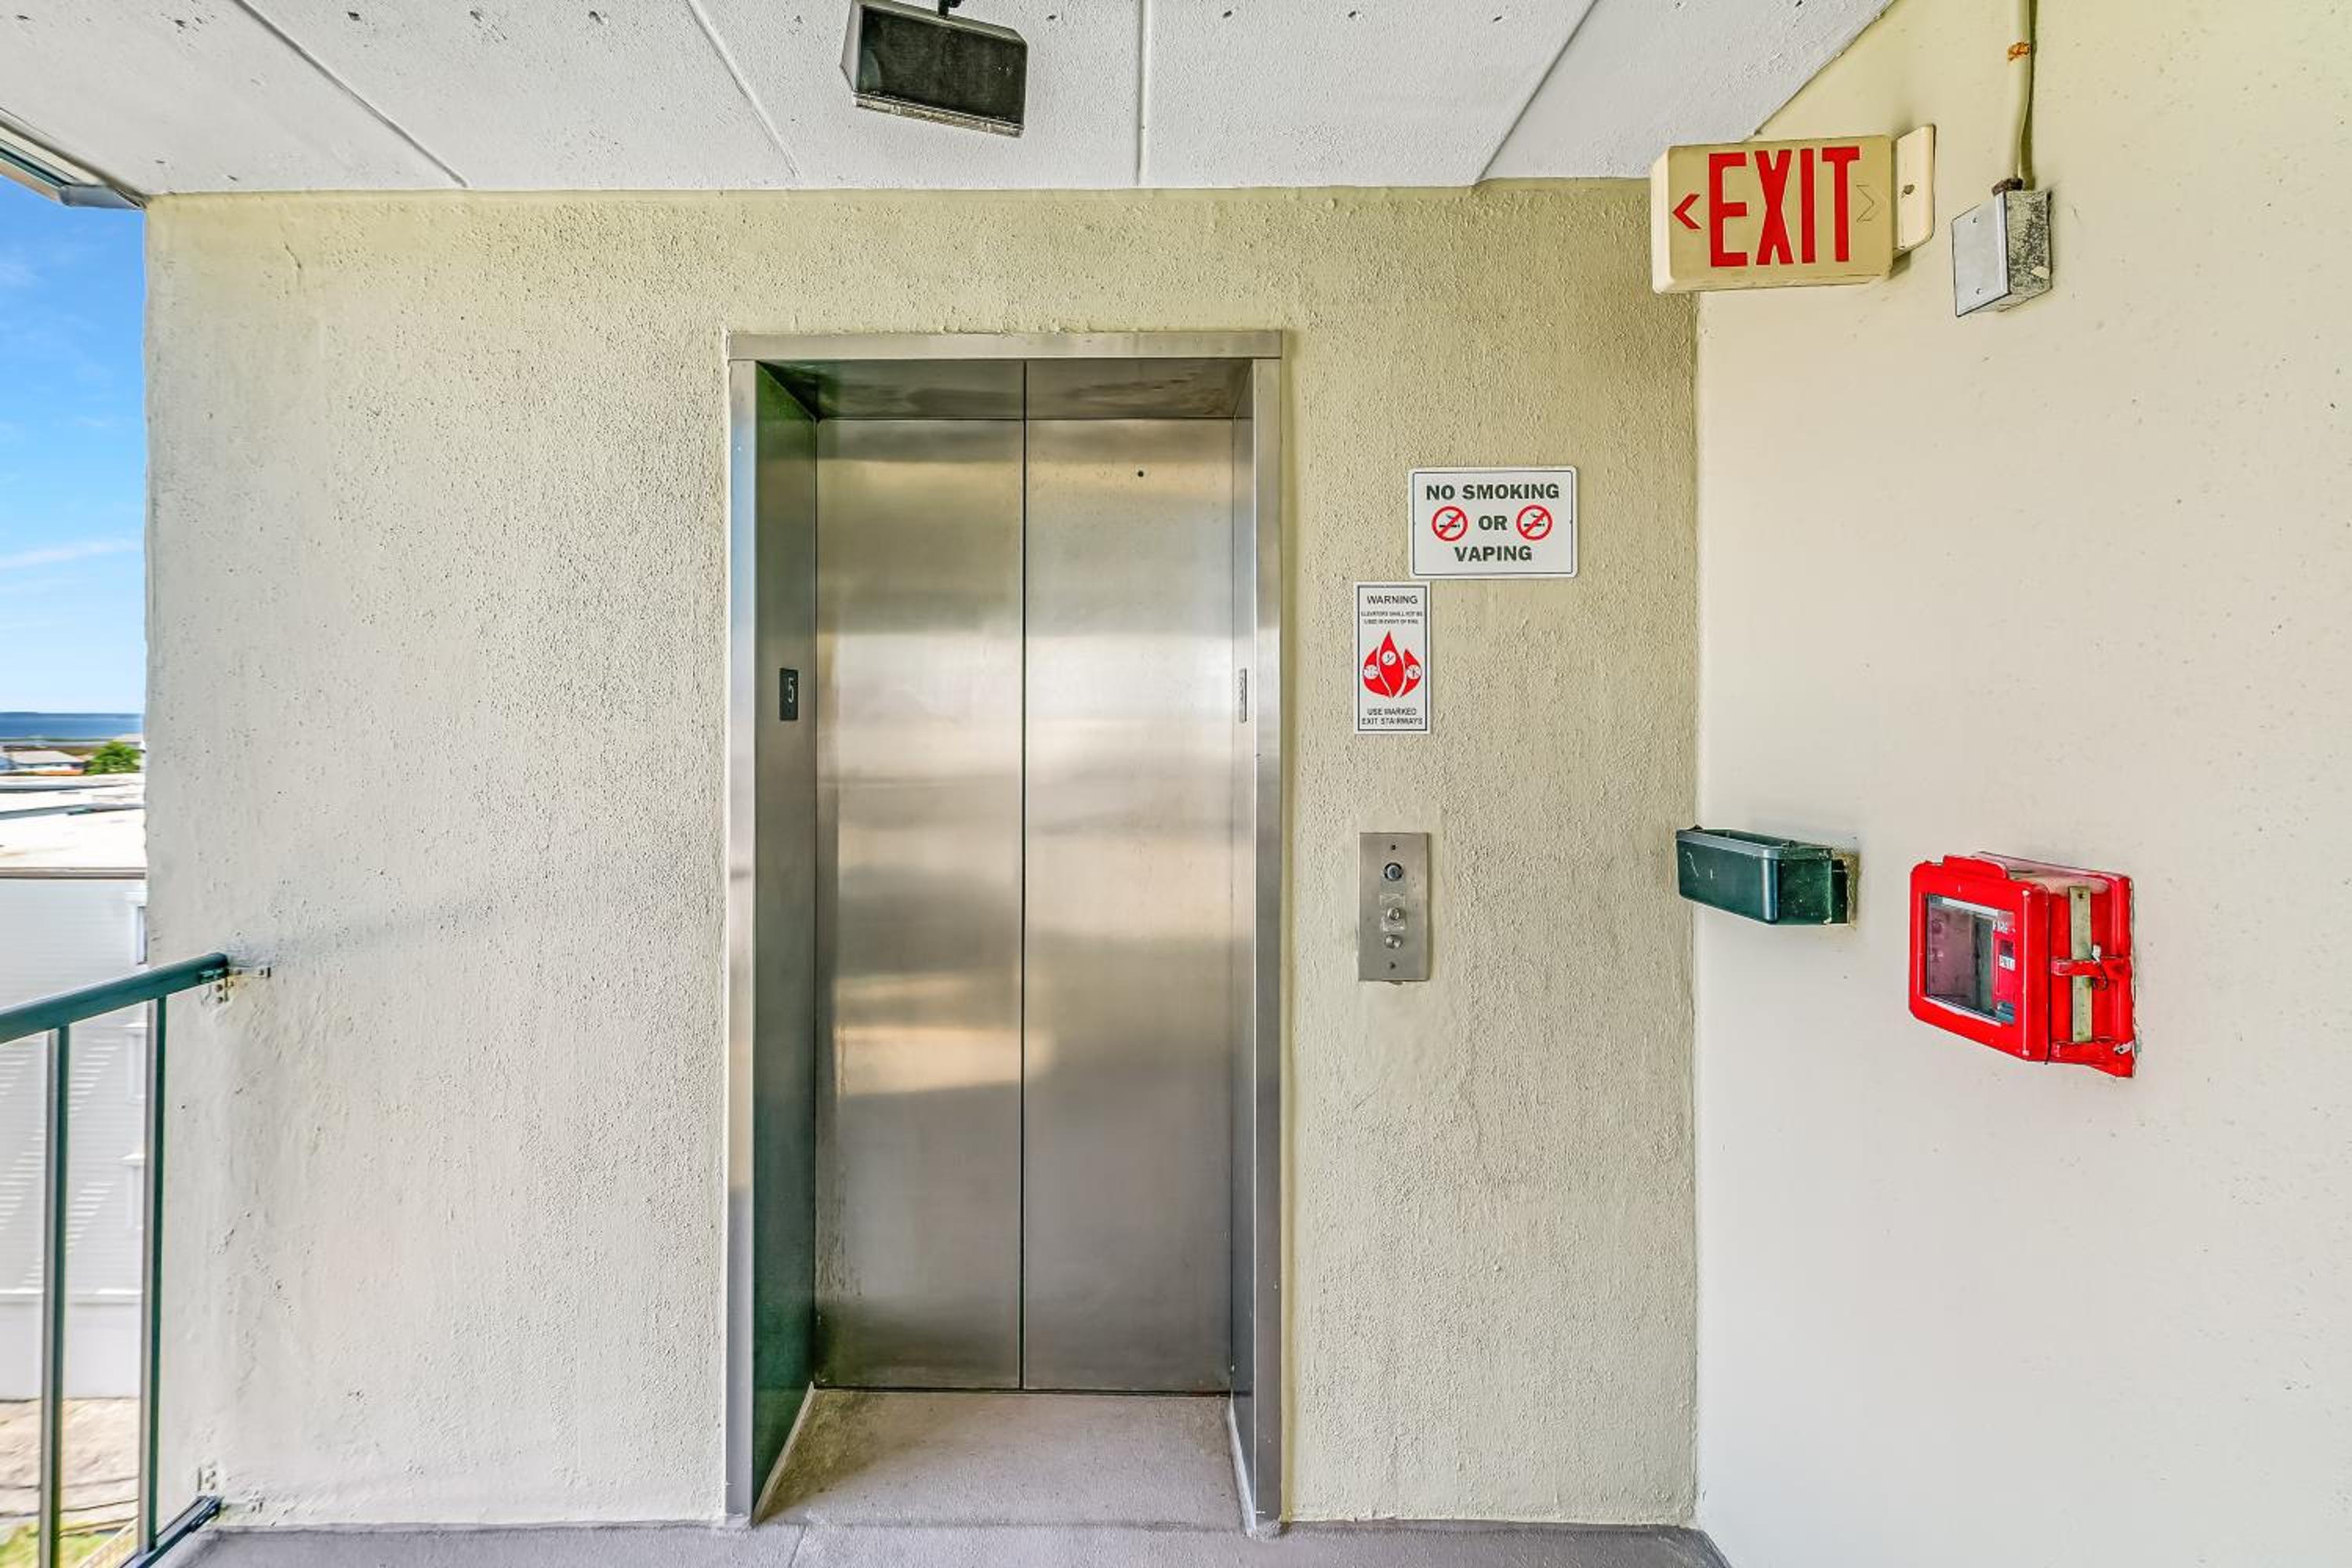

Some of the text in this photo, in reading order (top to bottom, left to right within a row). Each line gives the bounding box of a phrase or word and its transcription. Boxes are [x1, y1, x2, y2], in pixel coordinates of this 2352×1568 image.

[1708, 146, 1860, 267] EXIT
[1426, 483, 1559, 500] NO SMOKING
[1478, 515, 1508, 531] OR
[1454, 546, 1533, 561] VAPING
[1367, 595, 1418, 604] WARNING
[787, 677, 794, 703] 5
[1384, 707, 1417, 716] MARKED
